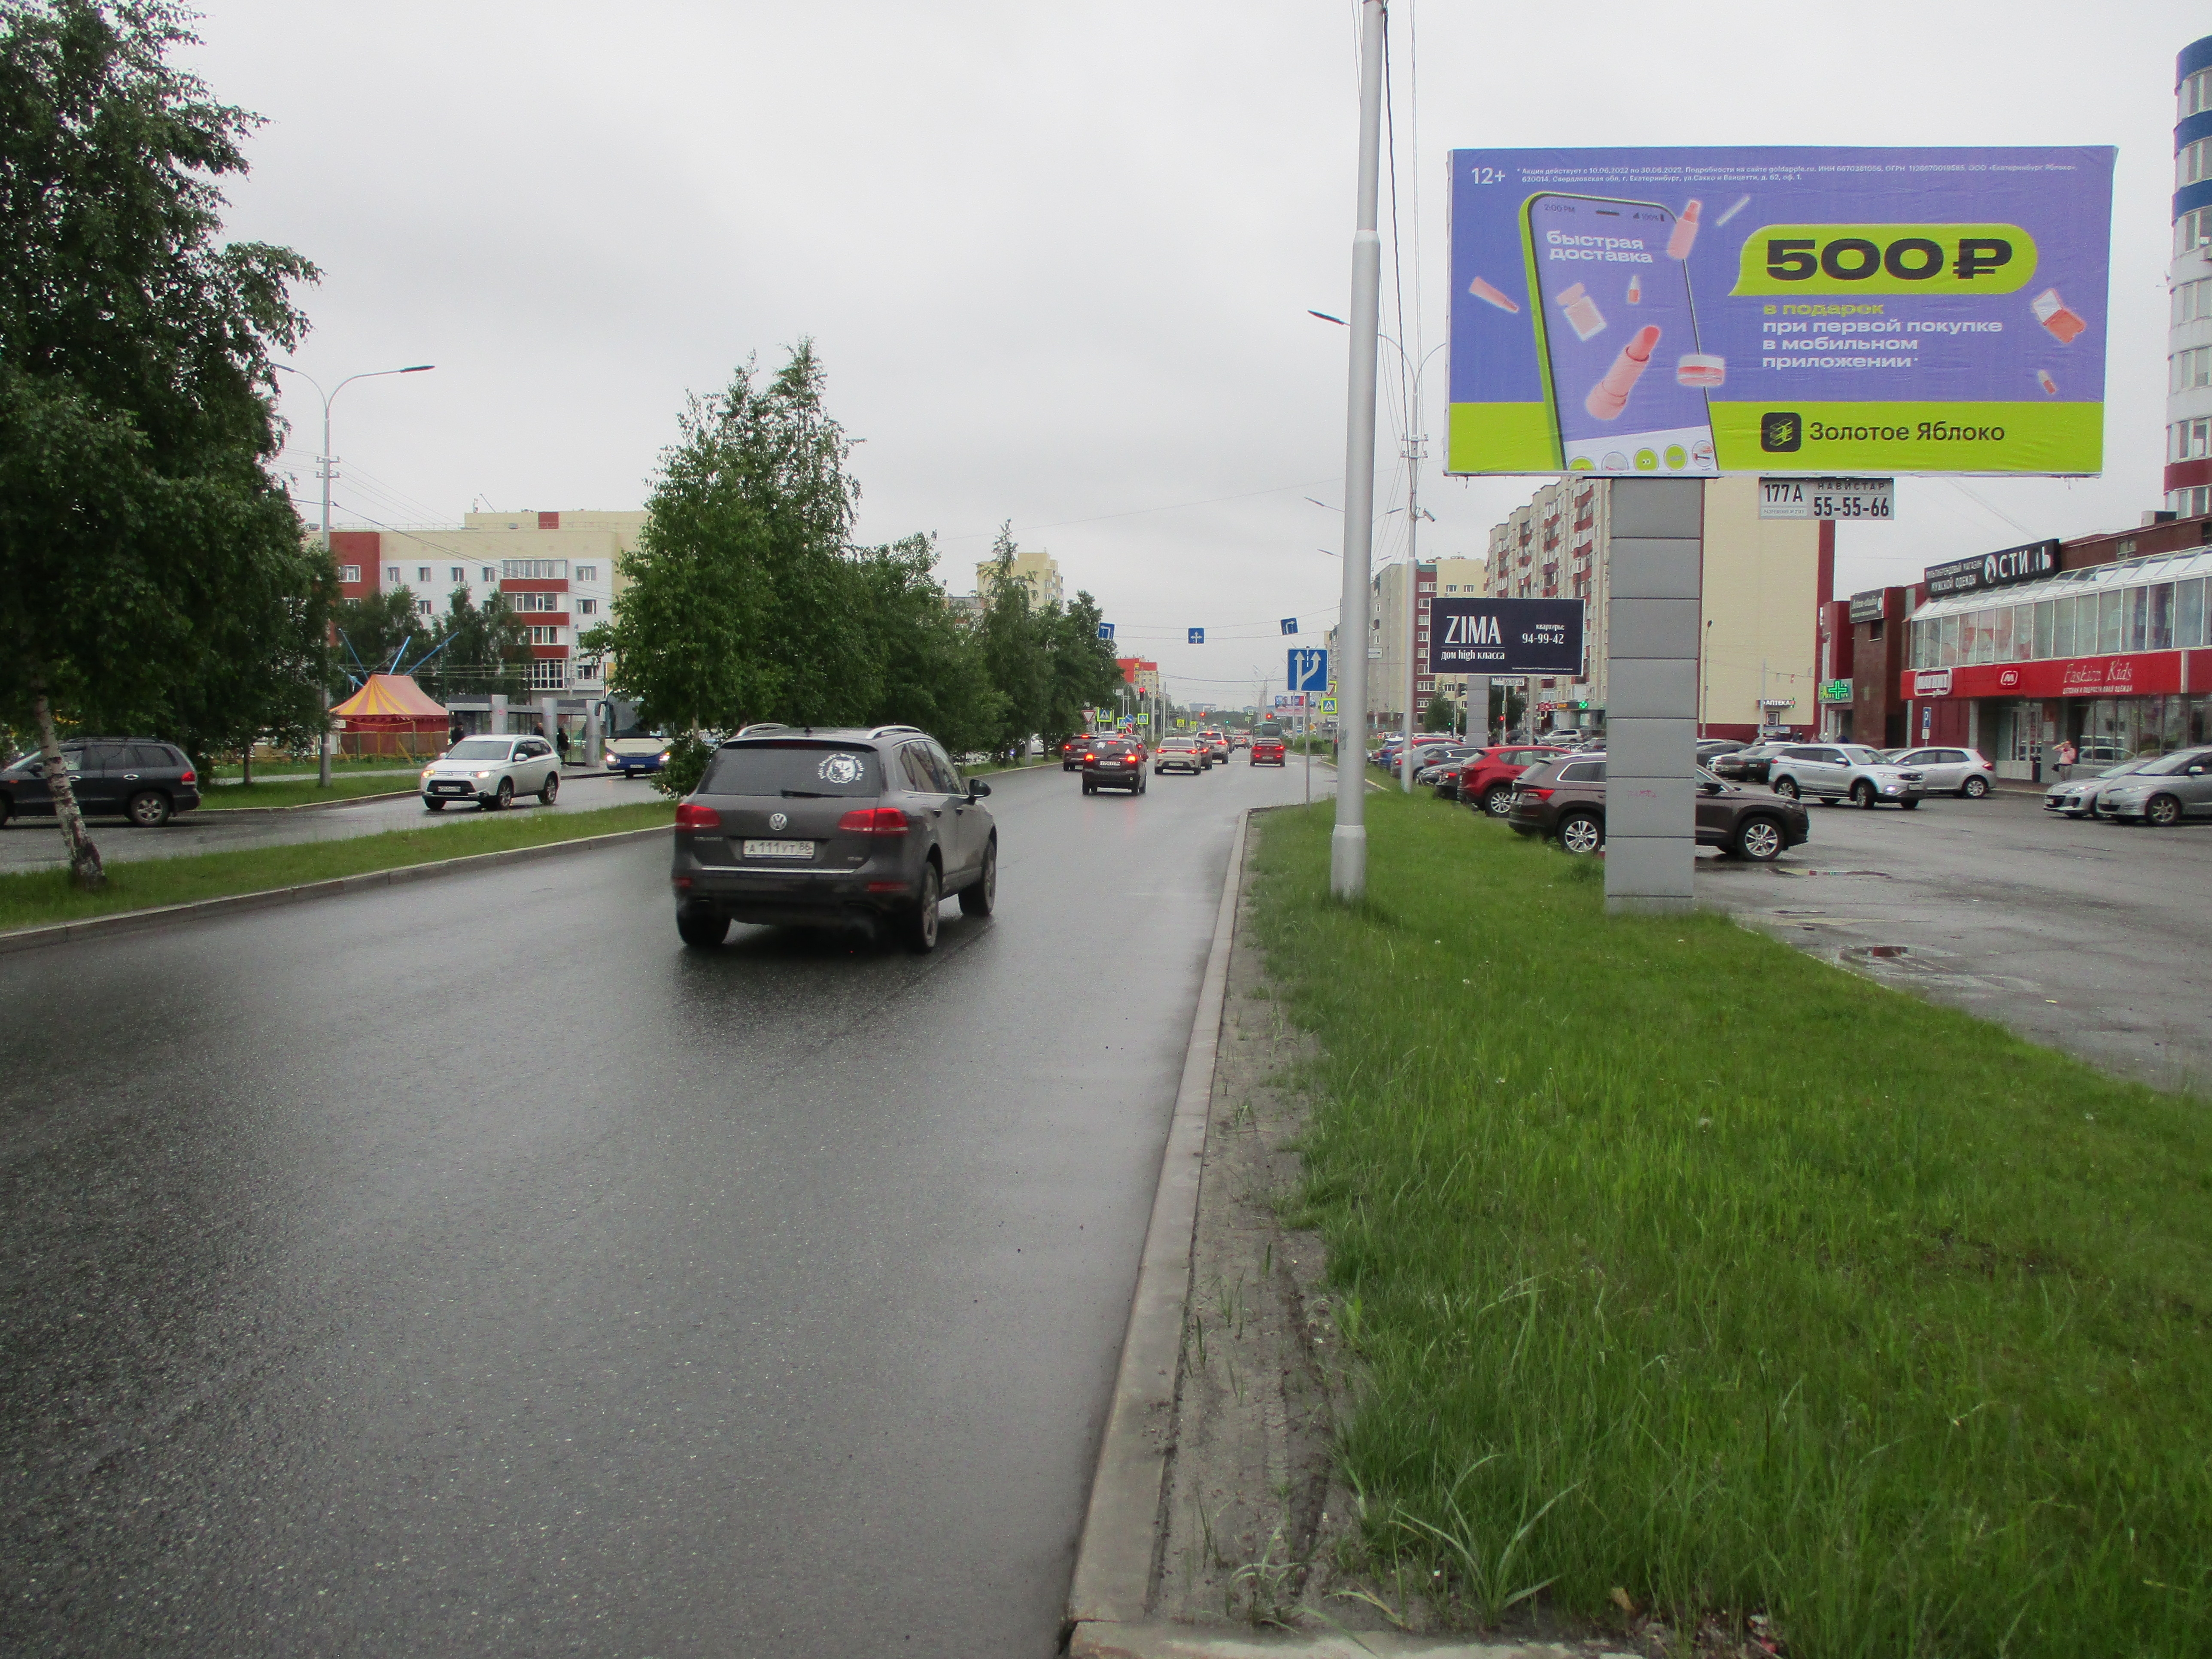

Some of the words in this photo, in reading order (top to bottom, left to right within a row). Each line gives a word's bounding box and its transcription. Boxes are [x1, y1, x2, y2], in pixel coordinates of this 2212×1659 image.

[1471, 167, 1506, 184] 12+
[1544, 204, 1562, 212] 2:00
[1547, 230, 1644, 250] быстрая
[1549, 248, 1653, 264] доставка
[1763, 304, 1777, 315] в
[1783, 304, 1884, 317] подарок
[1763, 322, 1807, 335] при
[1813, 318, 1901, 335] первой
[1907, 321, 2003, 335] покупке
[1762, 340, 1776, 350] в
[1782, 336, 1918, 350] мобильном
[1809, 421, 1909, 441] Золотое
[1917, 420, 2005, 441] Яблоко
[1813, 497, 1889, 517] 55-55-66
[1445, 616, 1502, 644] ZIMA
[1522, 633, 1564, 644] 94-99-42
[1441, 651, 1457, 661] дом
[1458, 649, 1476, 662] high
[1477, 651, 1505, 660] класса
[2105, 658, 2133, 683] Kids
